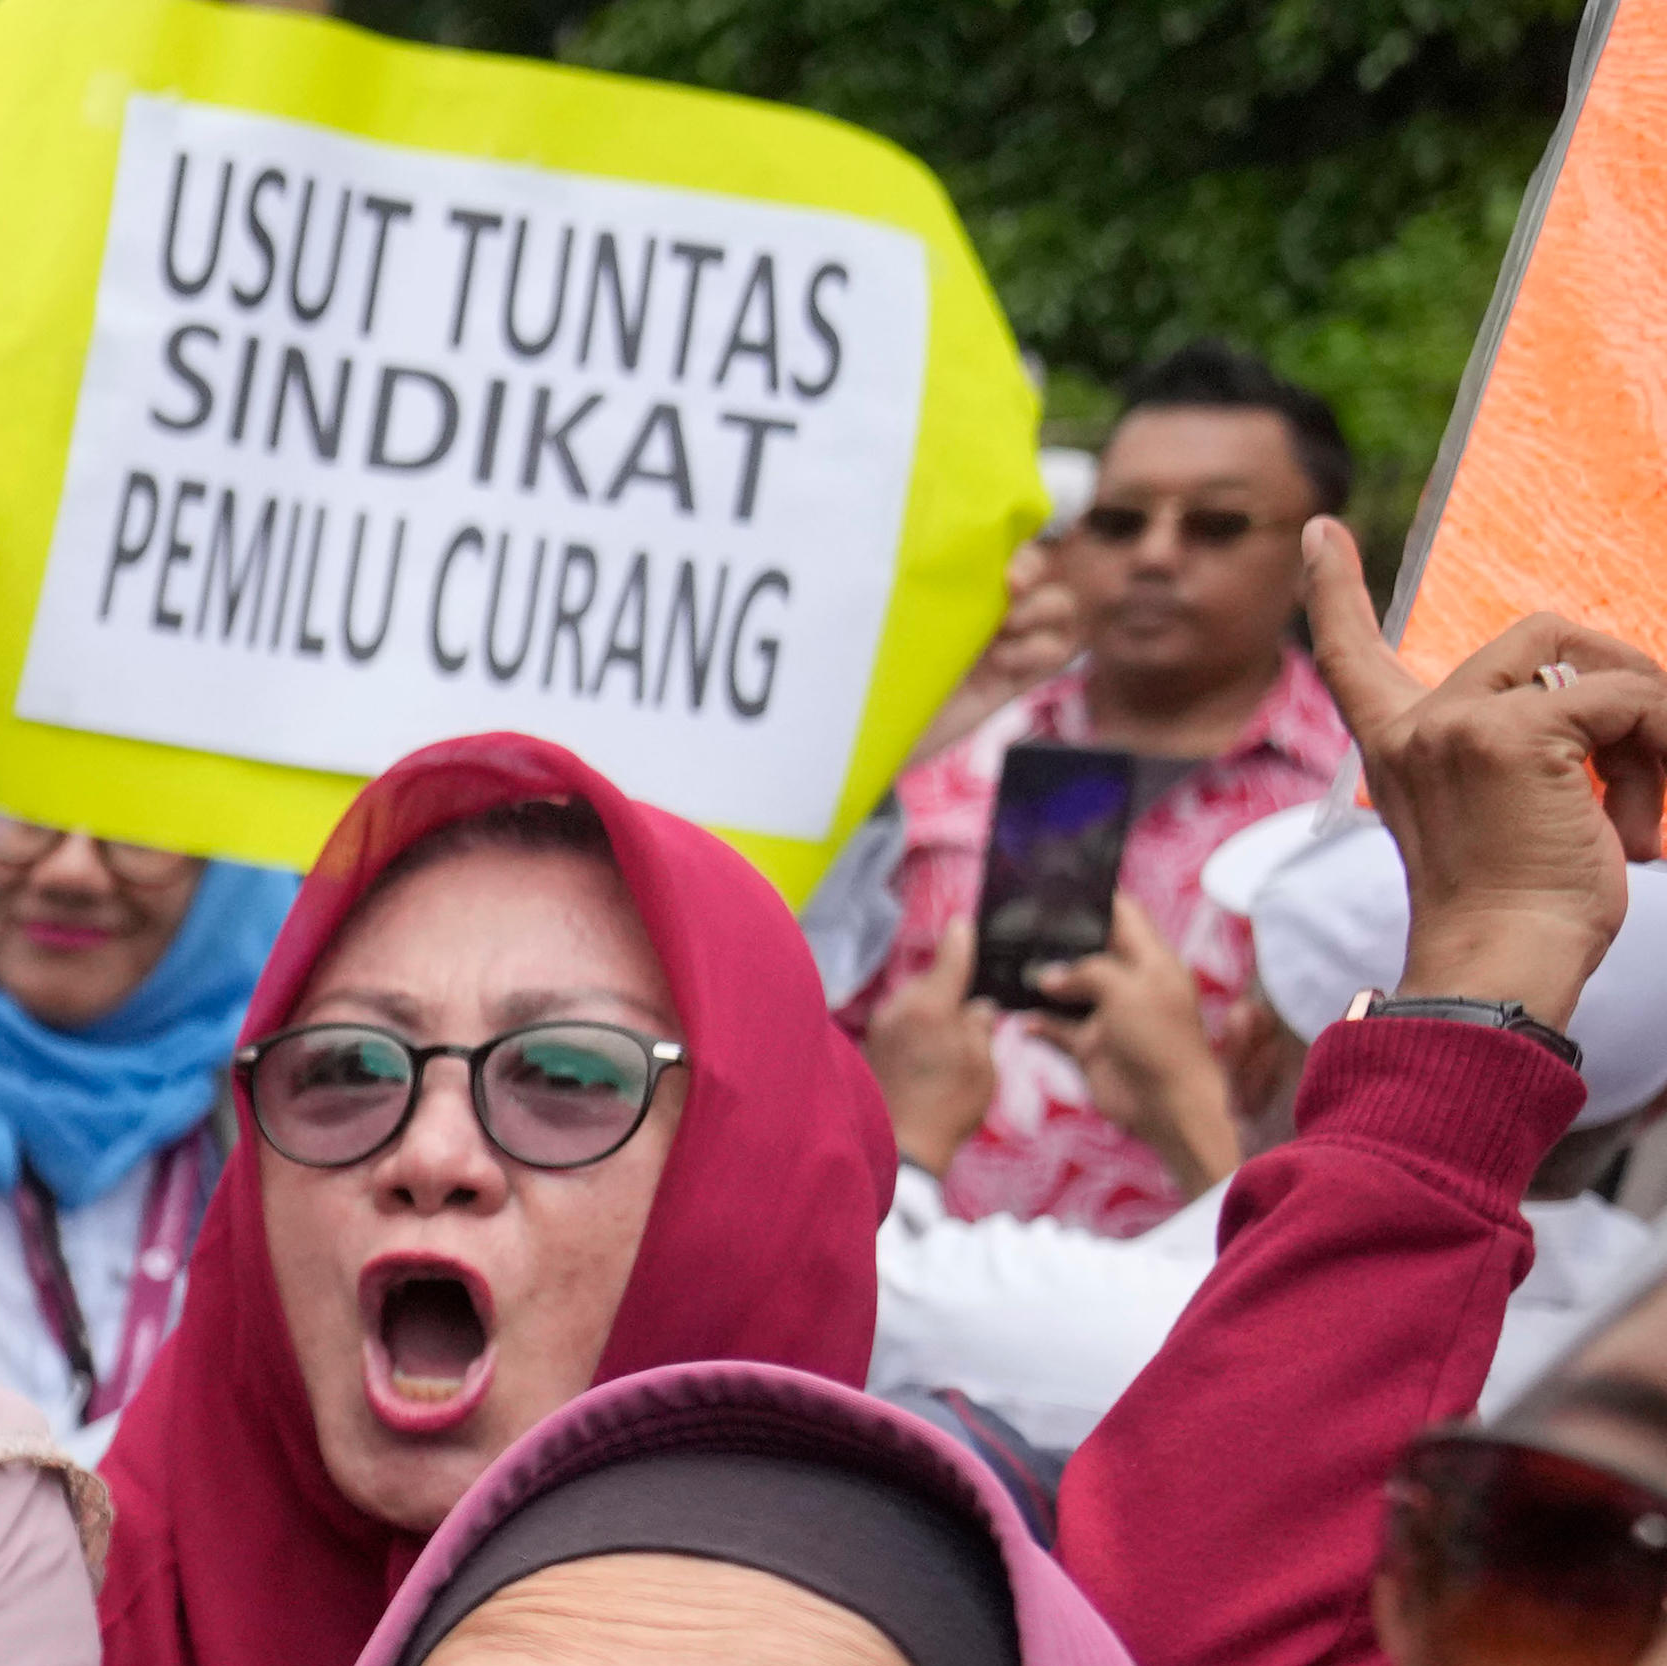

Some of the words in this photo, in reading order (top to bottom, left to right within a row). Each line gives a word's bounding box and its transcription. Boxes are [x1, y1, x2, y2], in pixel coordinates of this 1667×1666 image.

[161, 152, 412, 335] USUT
[443, 207, 850, 400] TUNTAS
[149, 322, 798, 521] SINDIKAT
[98, 470, 407, 664] PEMILU
[429, 525, 792, 721] CURANG
